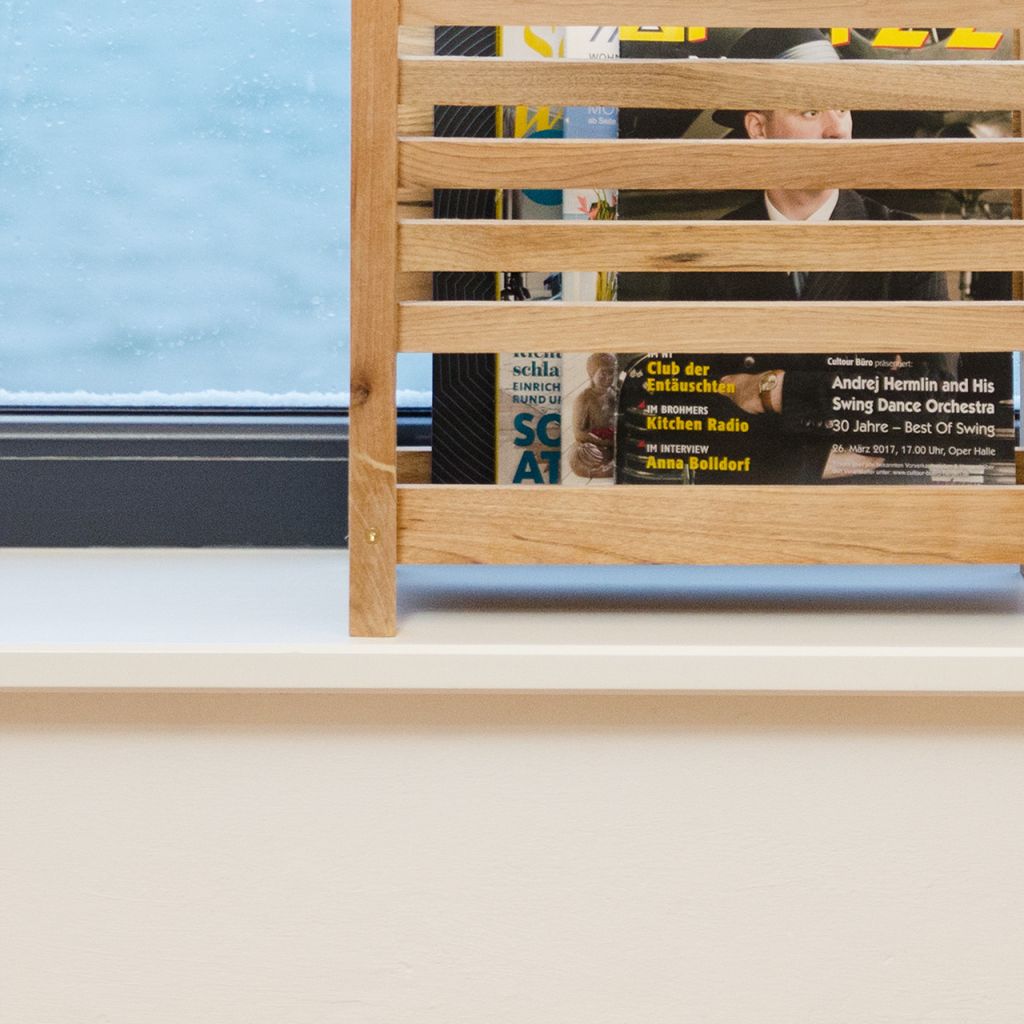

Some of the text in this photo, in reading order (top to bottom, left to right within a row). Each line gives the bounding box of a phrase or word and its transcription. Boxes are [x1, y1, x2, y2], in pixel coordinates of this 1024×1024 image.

[512, 361, 560, 376] schla
[647, 361, 710, 376] Club der
[827, 357, 854, 366] Cultour
[855, 357, 874, 366] Büro
[512, 382, 561, 392] EINRICH
[647, 378, 736, 393] Entäuschten
[832, 376, 995, 393] Andrej Hermlin and His
[512, 395, 546, 405] RUND
[832, 397, 995, 414] Swing Dance Orchestra
[647, 405, 709, 415] IM BROHMERS
[646, 416, 749, 432] Kitchen Radio
[832, 419, 849, 432] 30
[853, 420, 889, 433] Jahre
[905, 421, 932, 434] Best
[936, 421, 952, 434] Of
[956, 422, 995, 437] Swing
[646, 444, 709, 454] IM INTERVIEW
[849, 444, 871, 453] März
[873, 445, 898, 456] 2017,
[901, 445, 926, 455] 17.00
[928, 446, 946, 456] Uhr,
[948, 446, 972, 456] Oper
[974, 446, 996, 456] Halle
[512, 450, 561, 484] AT
[646, 456, 751, 471] Anna Bolldorf
